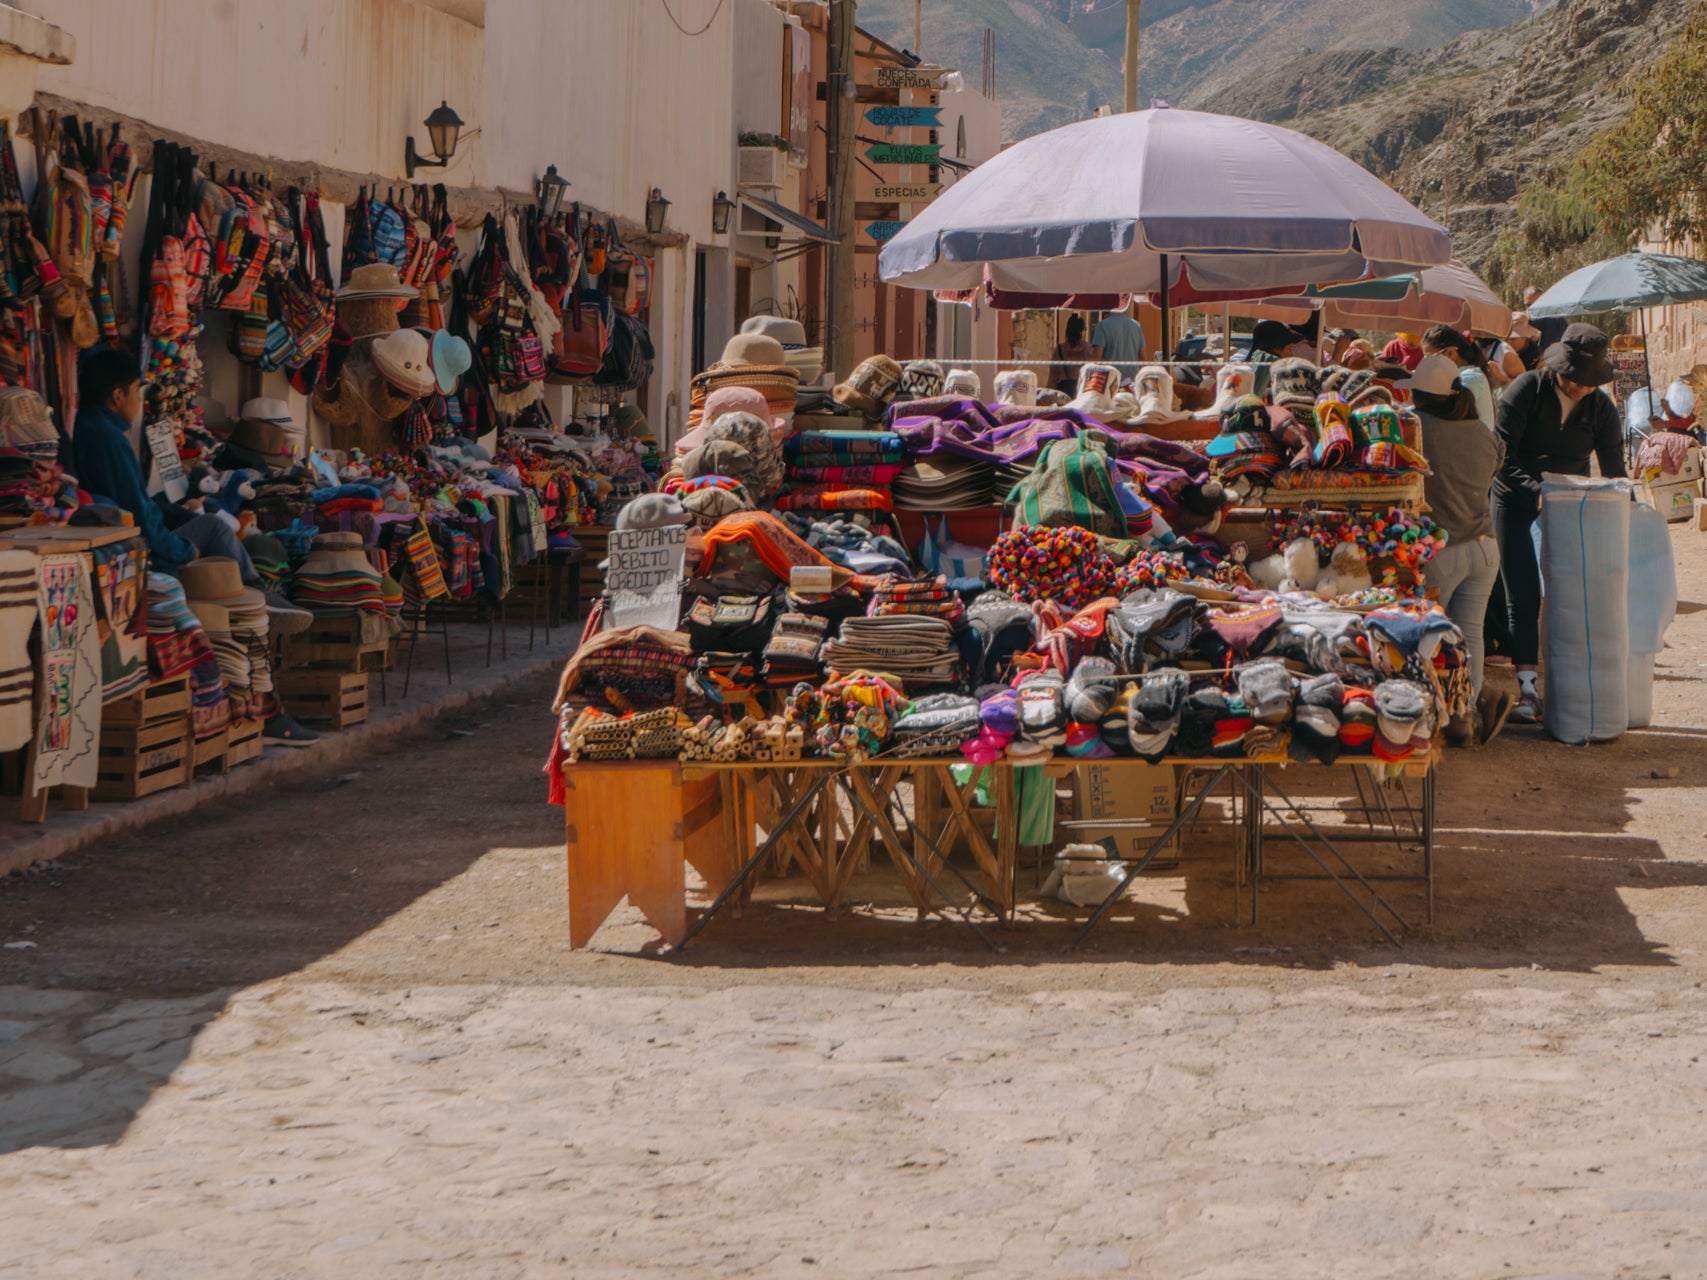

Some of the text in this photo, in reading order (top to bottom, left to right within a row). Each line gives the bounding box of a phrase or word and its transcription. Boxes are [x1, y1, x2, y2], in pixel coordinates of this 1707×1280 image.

[878, 69, 917, 78] NUECES
[877, 78, 932, 88] CONFITADA
[873, 107, 921, 117] HOJAS DE
[889, 145, 923, 155] YUYOS
[873, 154, 936, 164] MEDICINALES
[874, 187, 927, 198] ESPECIAS
[609, 527, 686, 550] ACEPTAMOS
[609, 549, 670, 571] DEBITO
[608, 568, 675, 591] CREDITO
